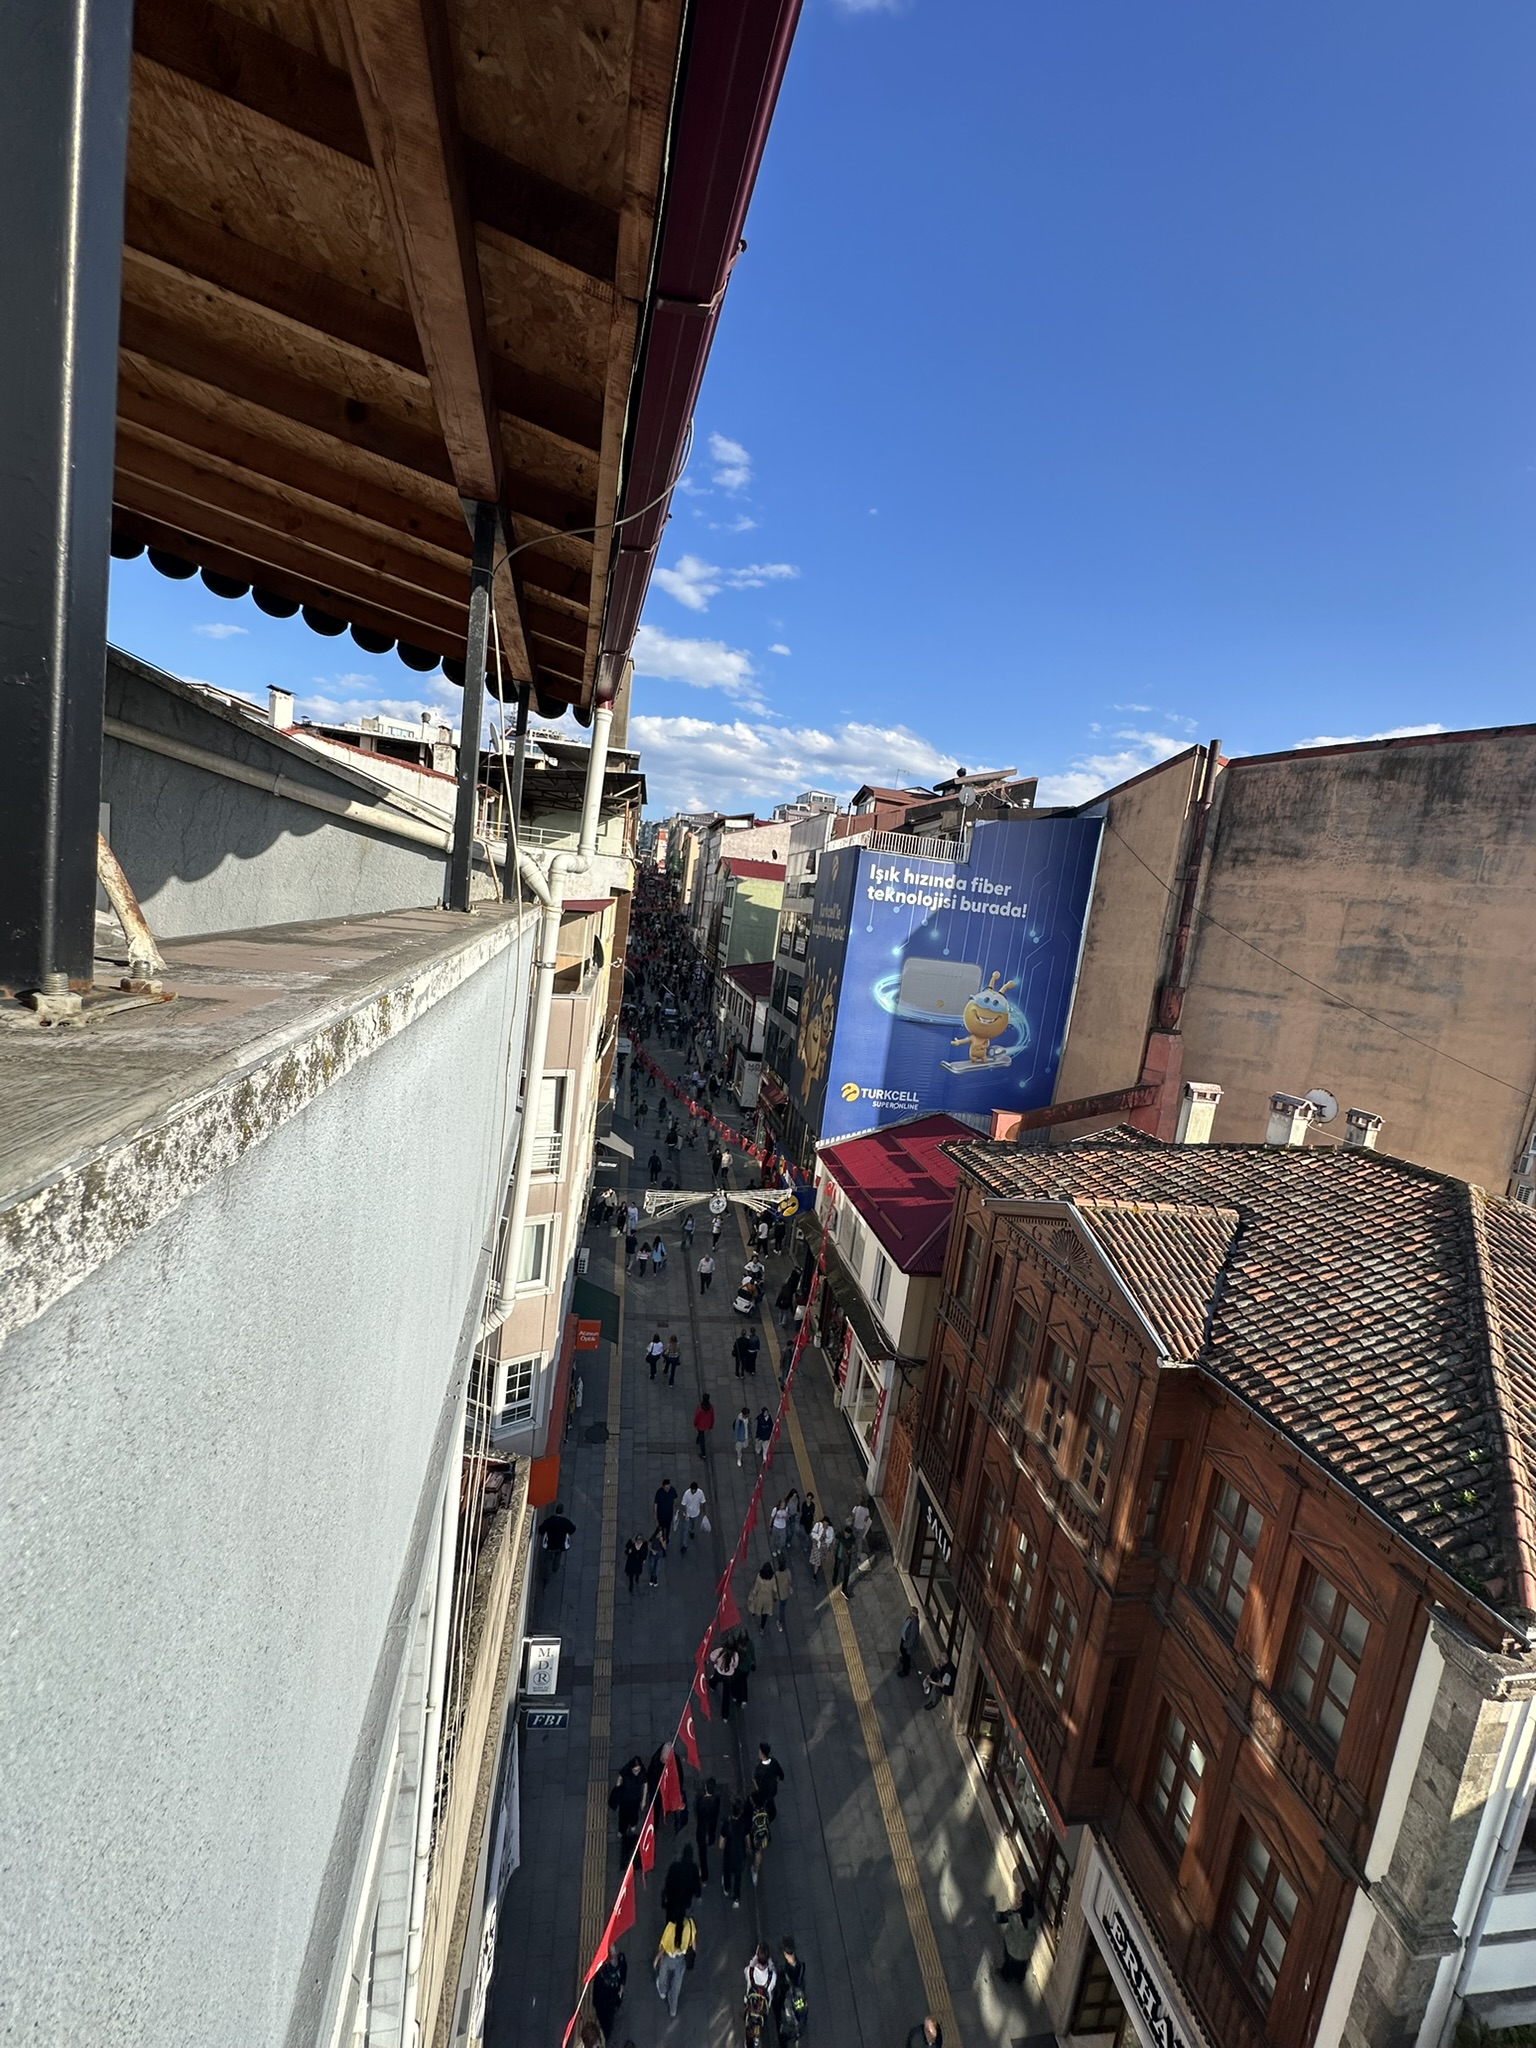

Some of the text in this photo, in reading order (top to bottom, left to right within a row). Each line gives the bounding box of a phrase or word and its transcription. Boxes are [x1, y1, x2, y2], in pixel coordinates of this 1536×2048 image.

[869, 864, 1012, 896] Işık hızında fiber
[867, 885, 1028, 919] teknolojisi burada!
[861, 1088, 919, 1102] TURKCELL
[872, 1100, 919, 1111] SUPERONLINE
[533, 1715, 563, 1726] FBI
[1107, 1914, 1180, 2048] ERHA
